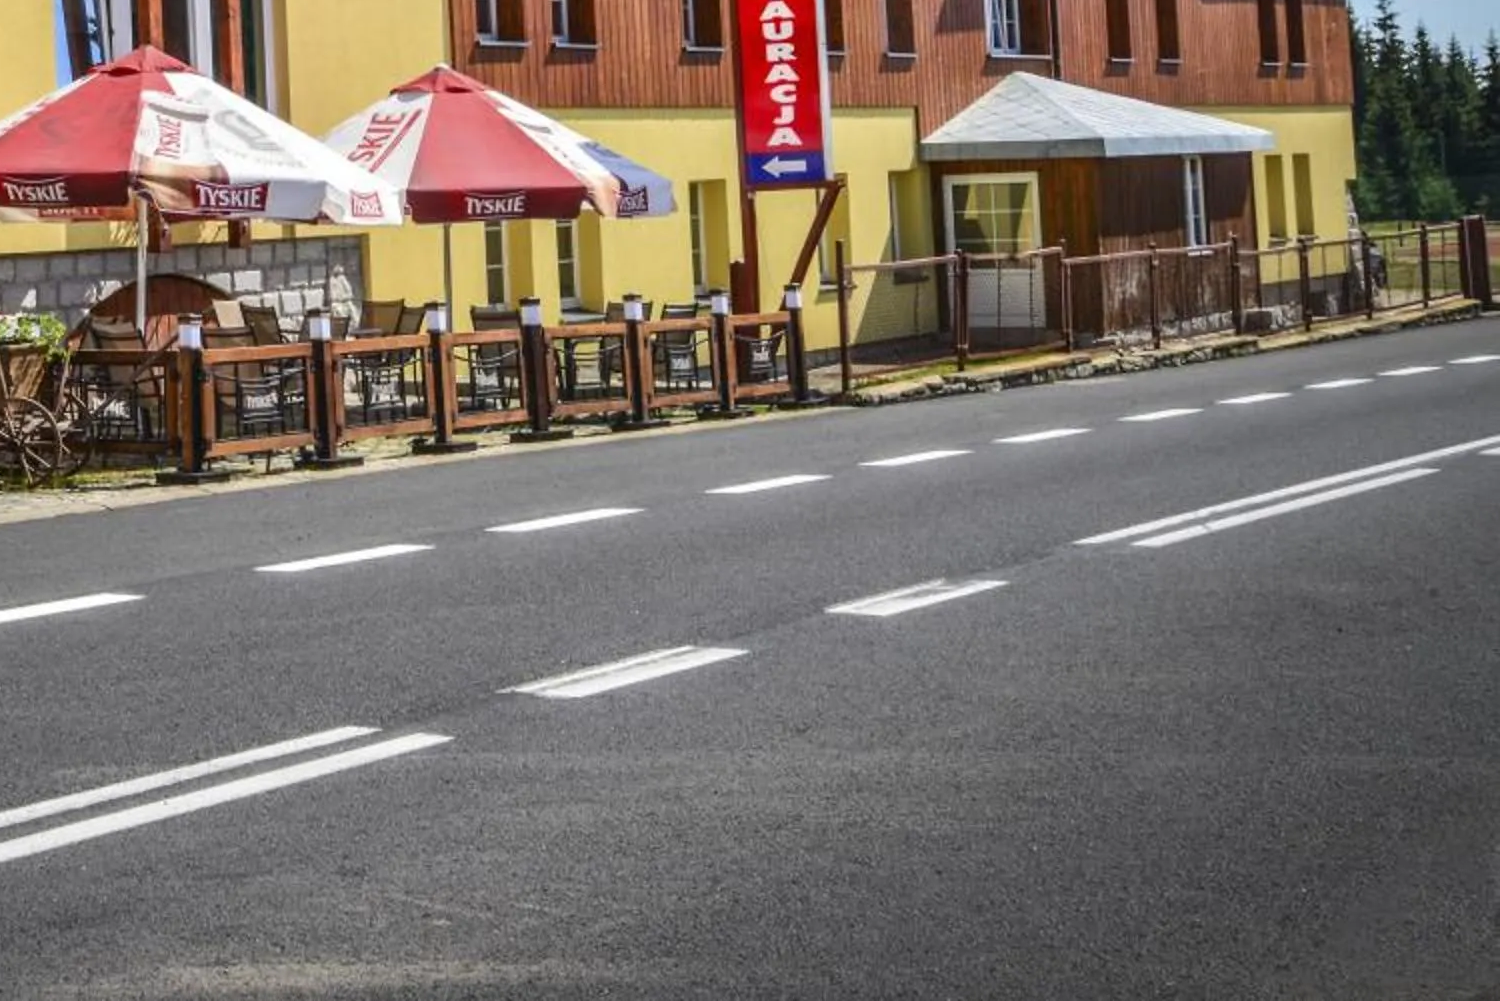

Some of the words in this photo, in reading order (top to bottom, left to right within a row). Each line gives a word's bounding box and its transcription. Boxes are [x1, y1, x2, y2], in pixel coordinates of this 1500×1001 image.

[347, 112, 405, 164] SKIE
[3, 182, 69, 202] TYSKIE
[196, 184, 262, 209] TYSKIE
[464, 195, 526, 214] TYSKIE
